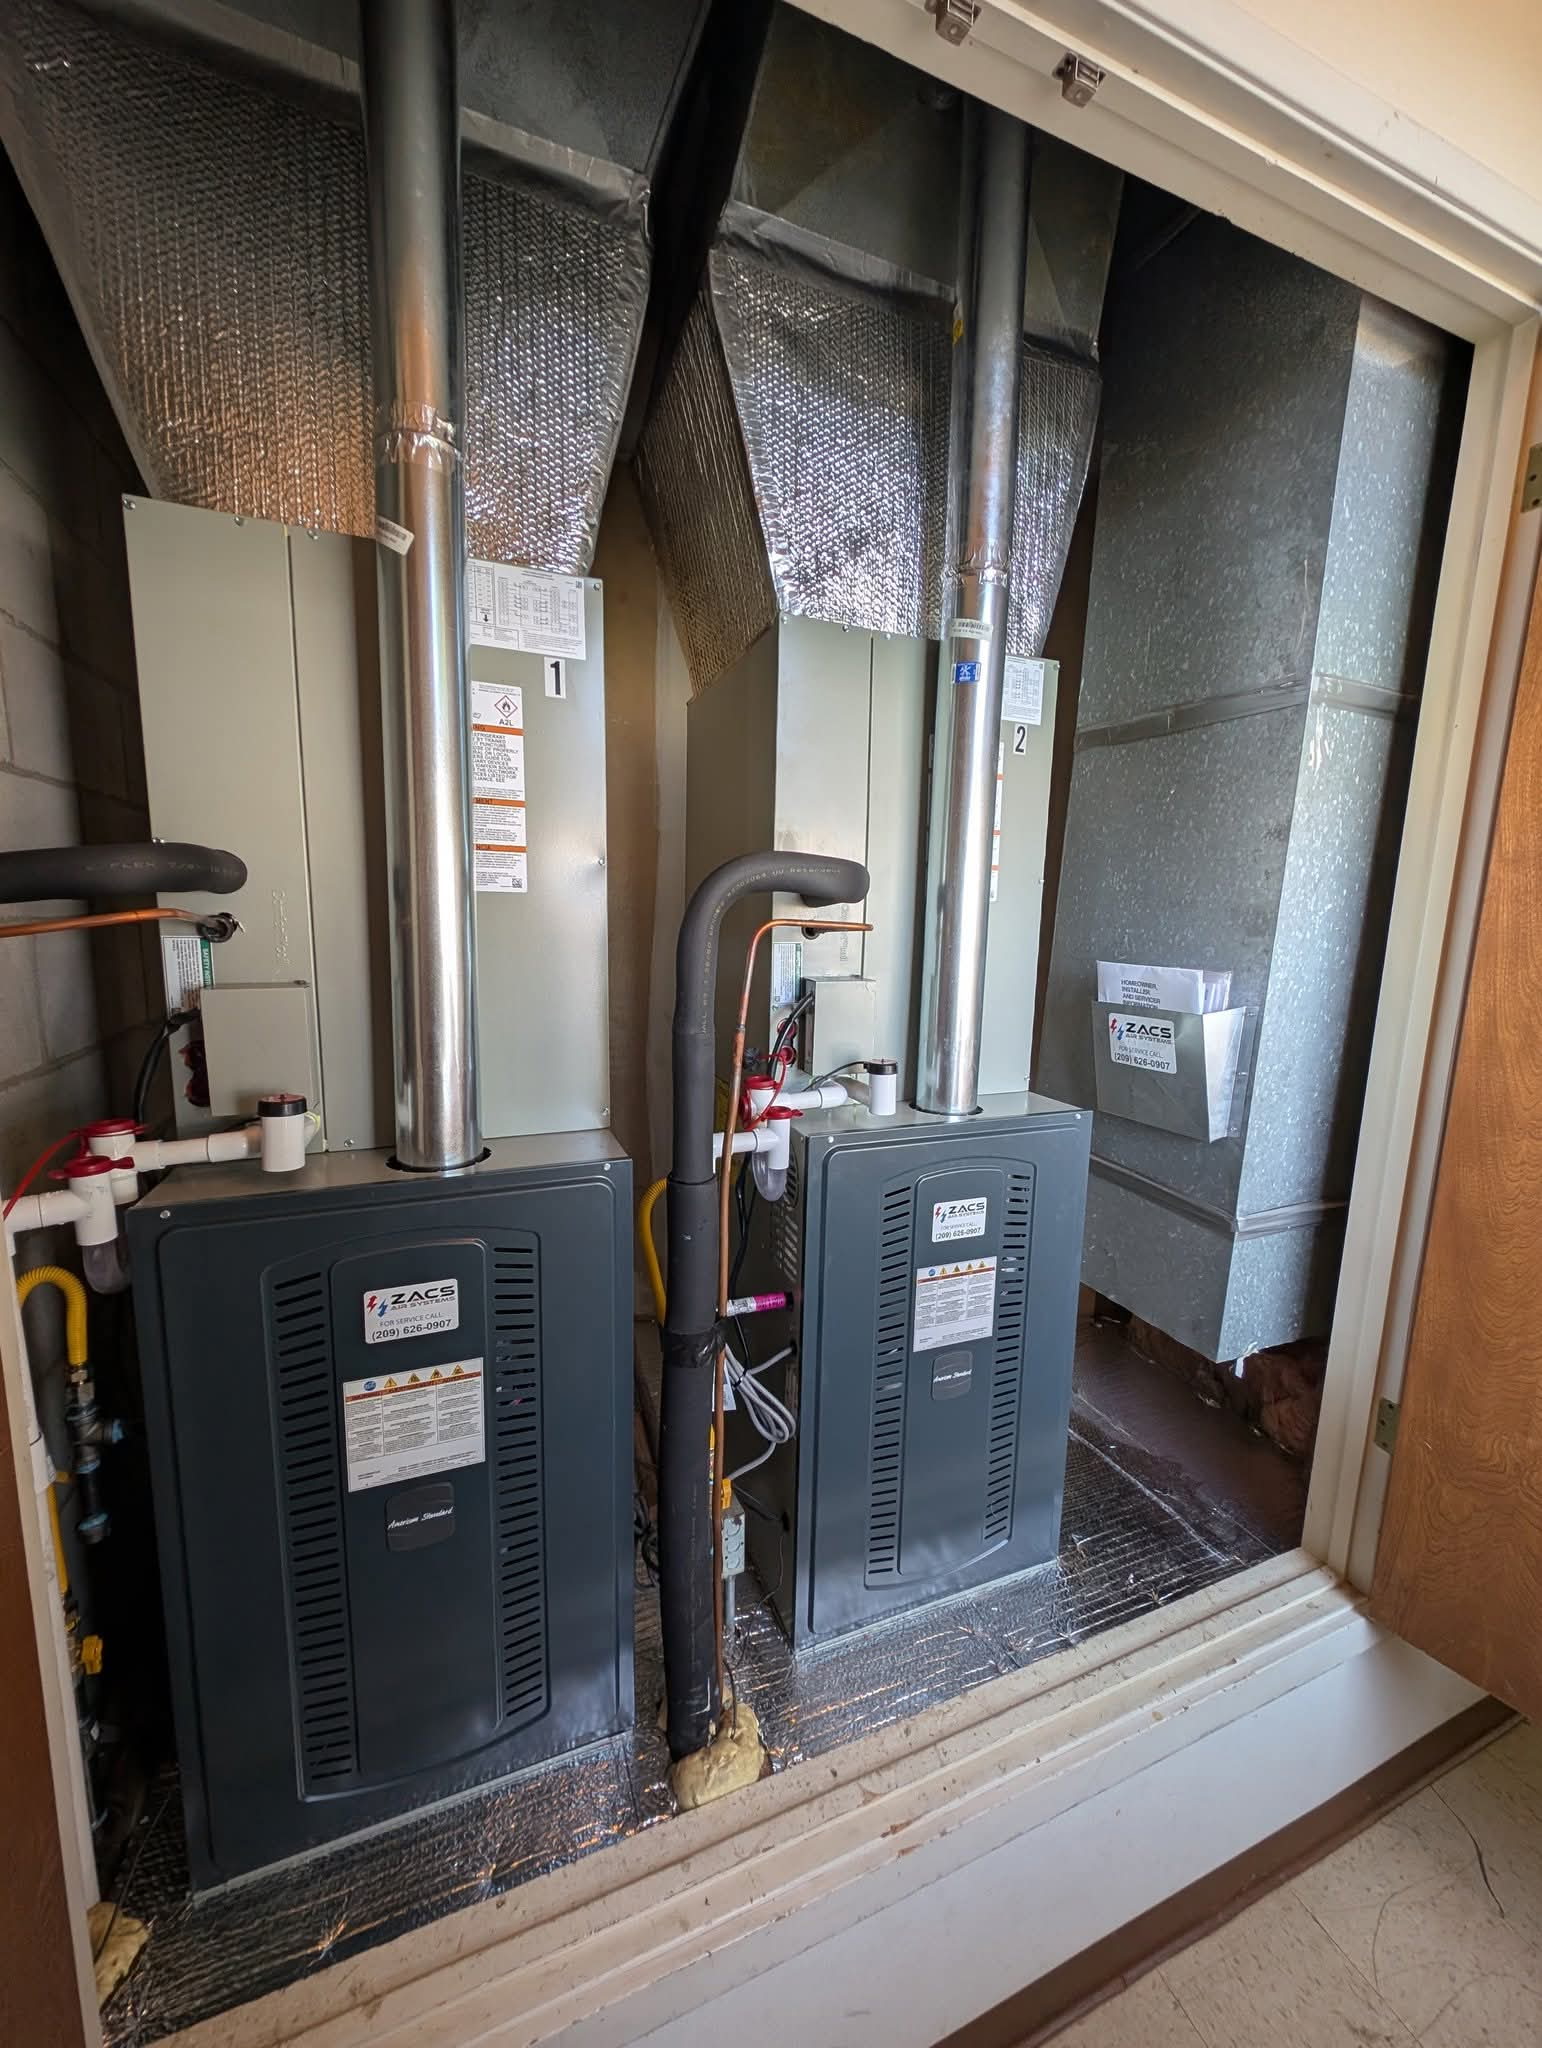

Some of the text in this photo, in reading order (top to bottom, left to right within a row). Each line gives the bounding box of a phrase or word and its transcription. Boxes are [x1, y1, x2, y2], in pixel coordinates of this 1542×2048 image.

[550, 660, 561, 696] 1
[1015, 725, 1026, 753] 2
[1126, 1022, 1172, 1038] ZACS
[1139, 1034, 1172, 1045] SYSTEMS
[1129, 1046, 1148, 1055] SERVICE
[1115, 1053, 1170, 1070] (209) 626-0907
[949, 1202, 985, 1214] ZACS
[936, 1231, 951, 1240] (209)
[390, 1285, 456, 1305] ZACS
[390, 1296, 457, 1311] AIR SYSTEMS
[380, 1319, 395, 1328] FOR
[396, 1315, 423, 1325] SERVICE
[372, 1319, 452, 1342] (209) 626-0907
[387, 1506, 454, 1530] American Standard
